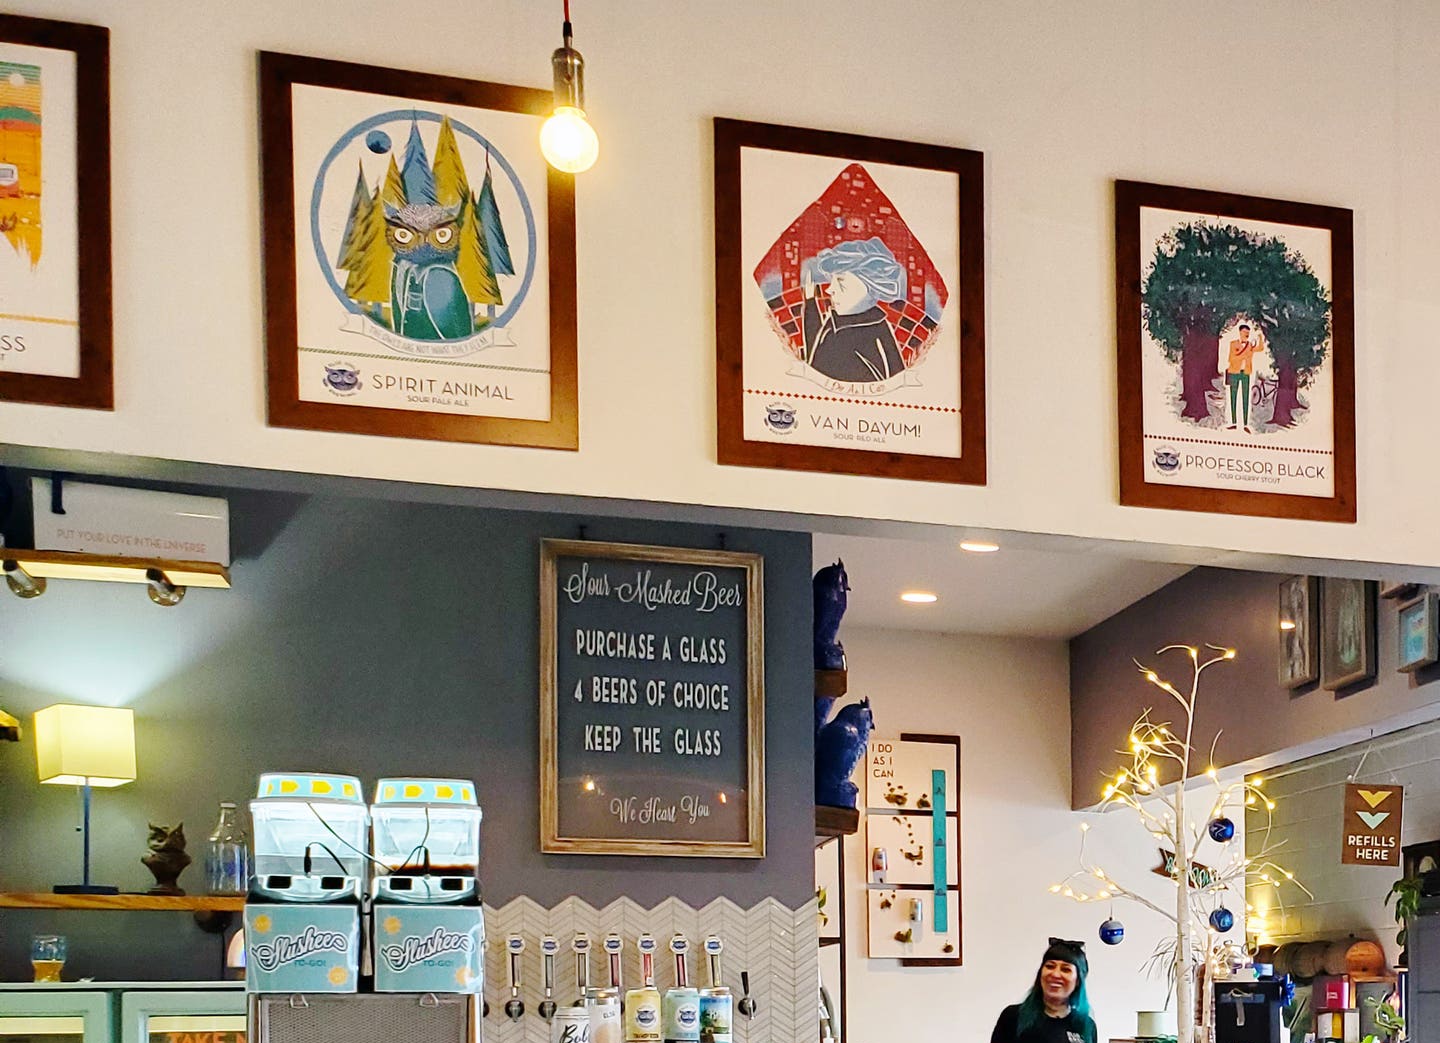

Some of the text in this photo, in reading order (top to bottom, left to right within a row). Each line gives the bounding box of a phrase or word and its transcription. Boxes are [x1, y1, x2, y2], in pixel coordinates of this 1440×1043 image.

[372, 374, 437, 393] SPIRIT
[442, 380, 514, 401] ANIMAL
[407, 394, 470, 407] SOUR PALE ALE
[810, 414, 849, 431] VAN
[858, 419, 921, 438] DAYUM!
[833, 432, 855, 442] SOUR
[873, 436, 887, 445] ALE
[1185, 454, 1274, 475] PROFESSOR
[1278, 463, 1326, 480] BLACK
[1215, 472, 1281, 485] SOUR CHERRY STOUT
[563, 562, 742, 612] Sour Mashed Beer
[576, 629, 727, 664] PURCHASE A GLASS
[574, 676, 729, 711] 4 BEERS OF CHOICE
[585, 724, 721, 756] KEEP THE GLASS
[878, 744, 893, 753] DO
[873, 756, 886, 766] AS
[873, 768, 894, 778] CAN
[610, 795, 710, 825] We Heart You
[1348, 835, 1395, 848] REFILLS
[1356, 848, 1389, 860] HERE
[251, 925, 348, 972] Slushee
[381, 925, 474, 972] Slushee
